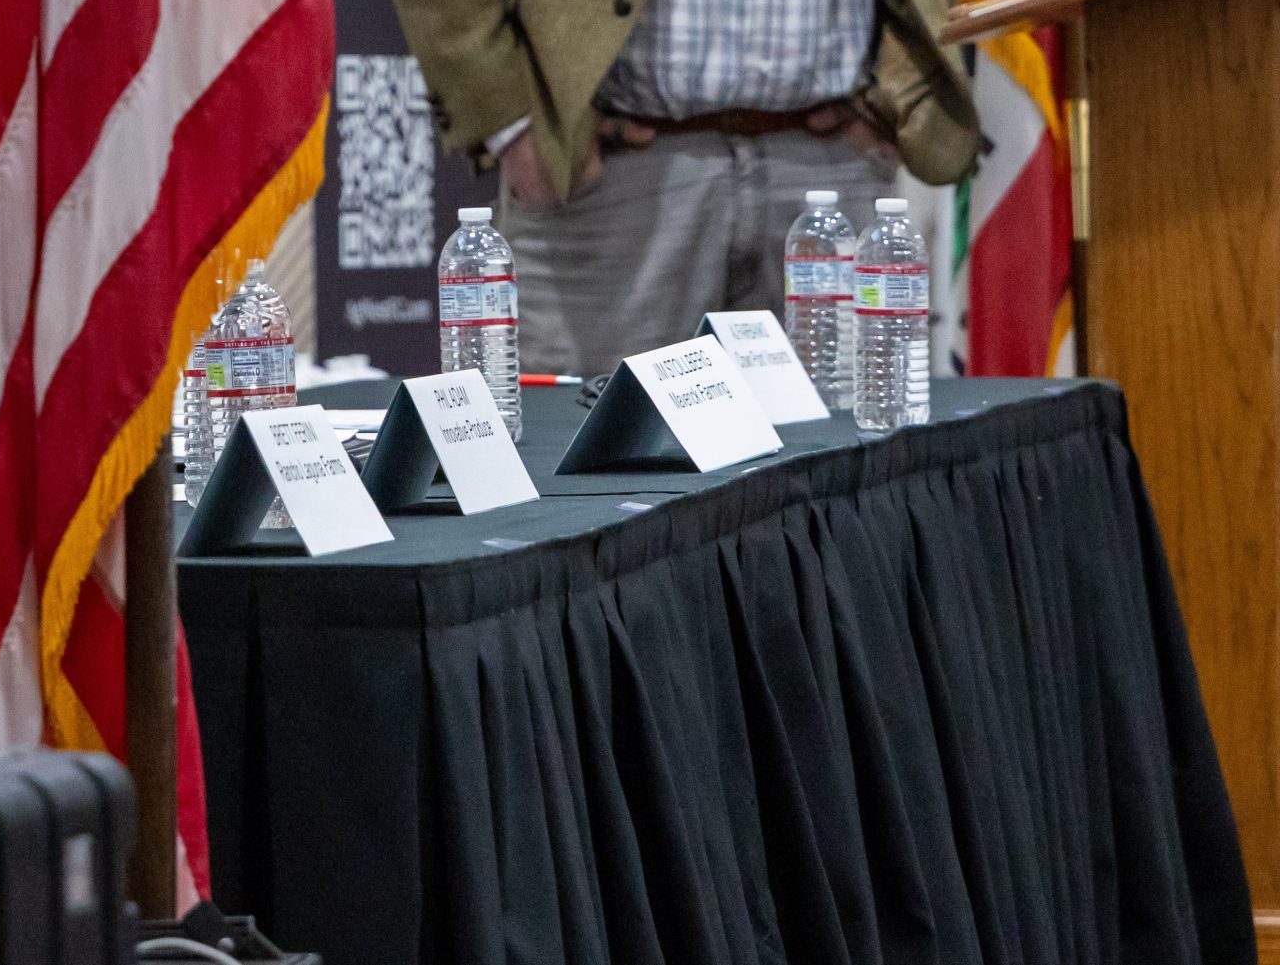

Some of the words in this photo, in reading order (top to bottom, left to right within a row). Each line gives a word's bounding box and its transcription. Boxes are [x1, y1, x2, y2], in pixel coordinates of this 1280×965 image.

[664, 349, 712, 379] STOLLBERG
[696, 380, 733, 404] Farming
[465, 415, 494, 440] Produce
